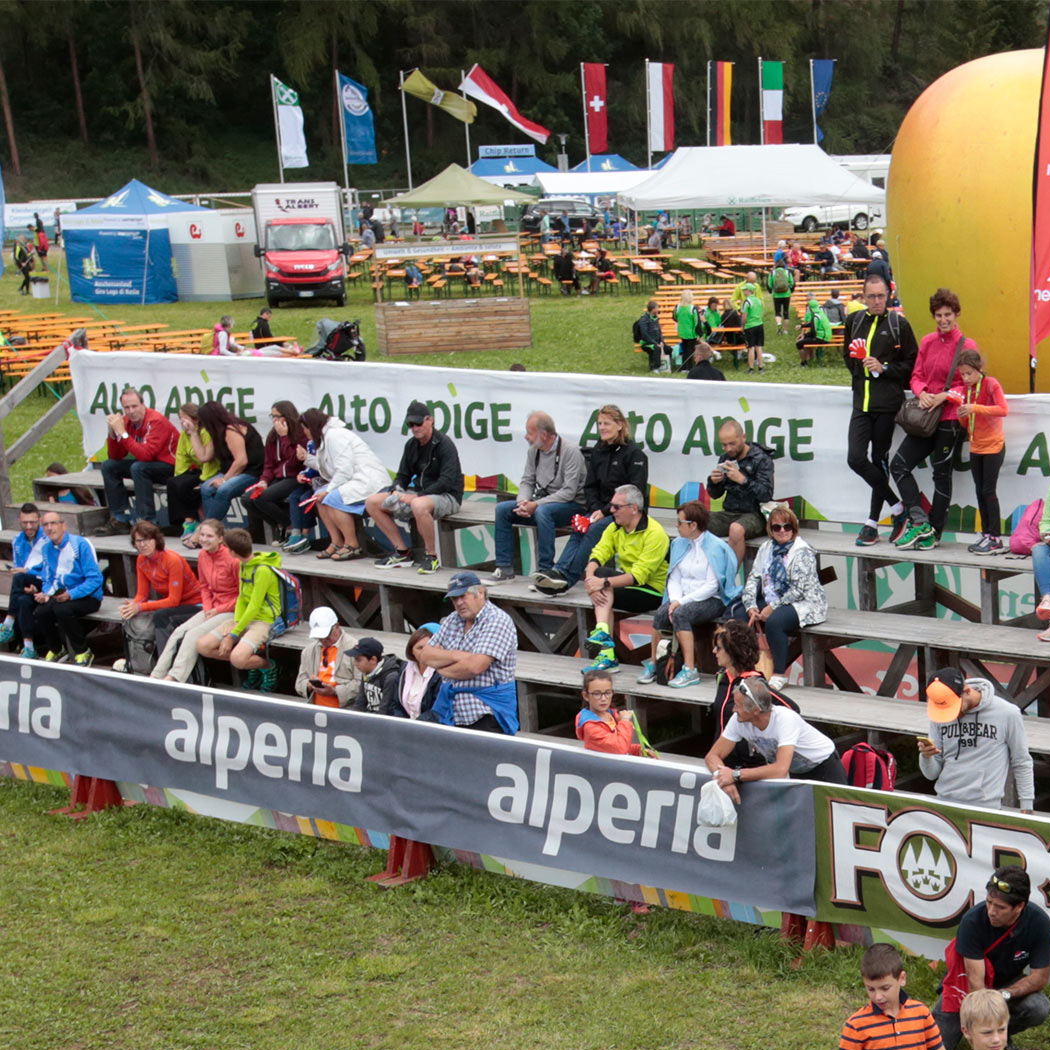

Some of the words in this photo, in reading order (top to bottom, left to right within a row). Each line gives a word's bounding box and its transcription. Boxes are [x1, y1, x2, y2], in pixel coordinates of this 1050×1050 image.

[484, 147, 502, 156] Chip
[503, 146, 530, 155] Return
[579, 408, 673, 453] ATO
[164, 693, 364, 792] alperia
